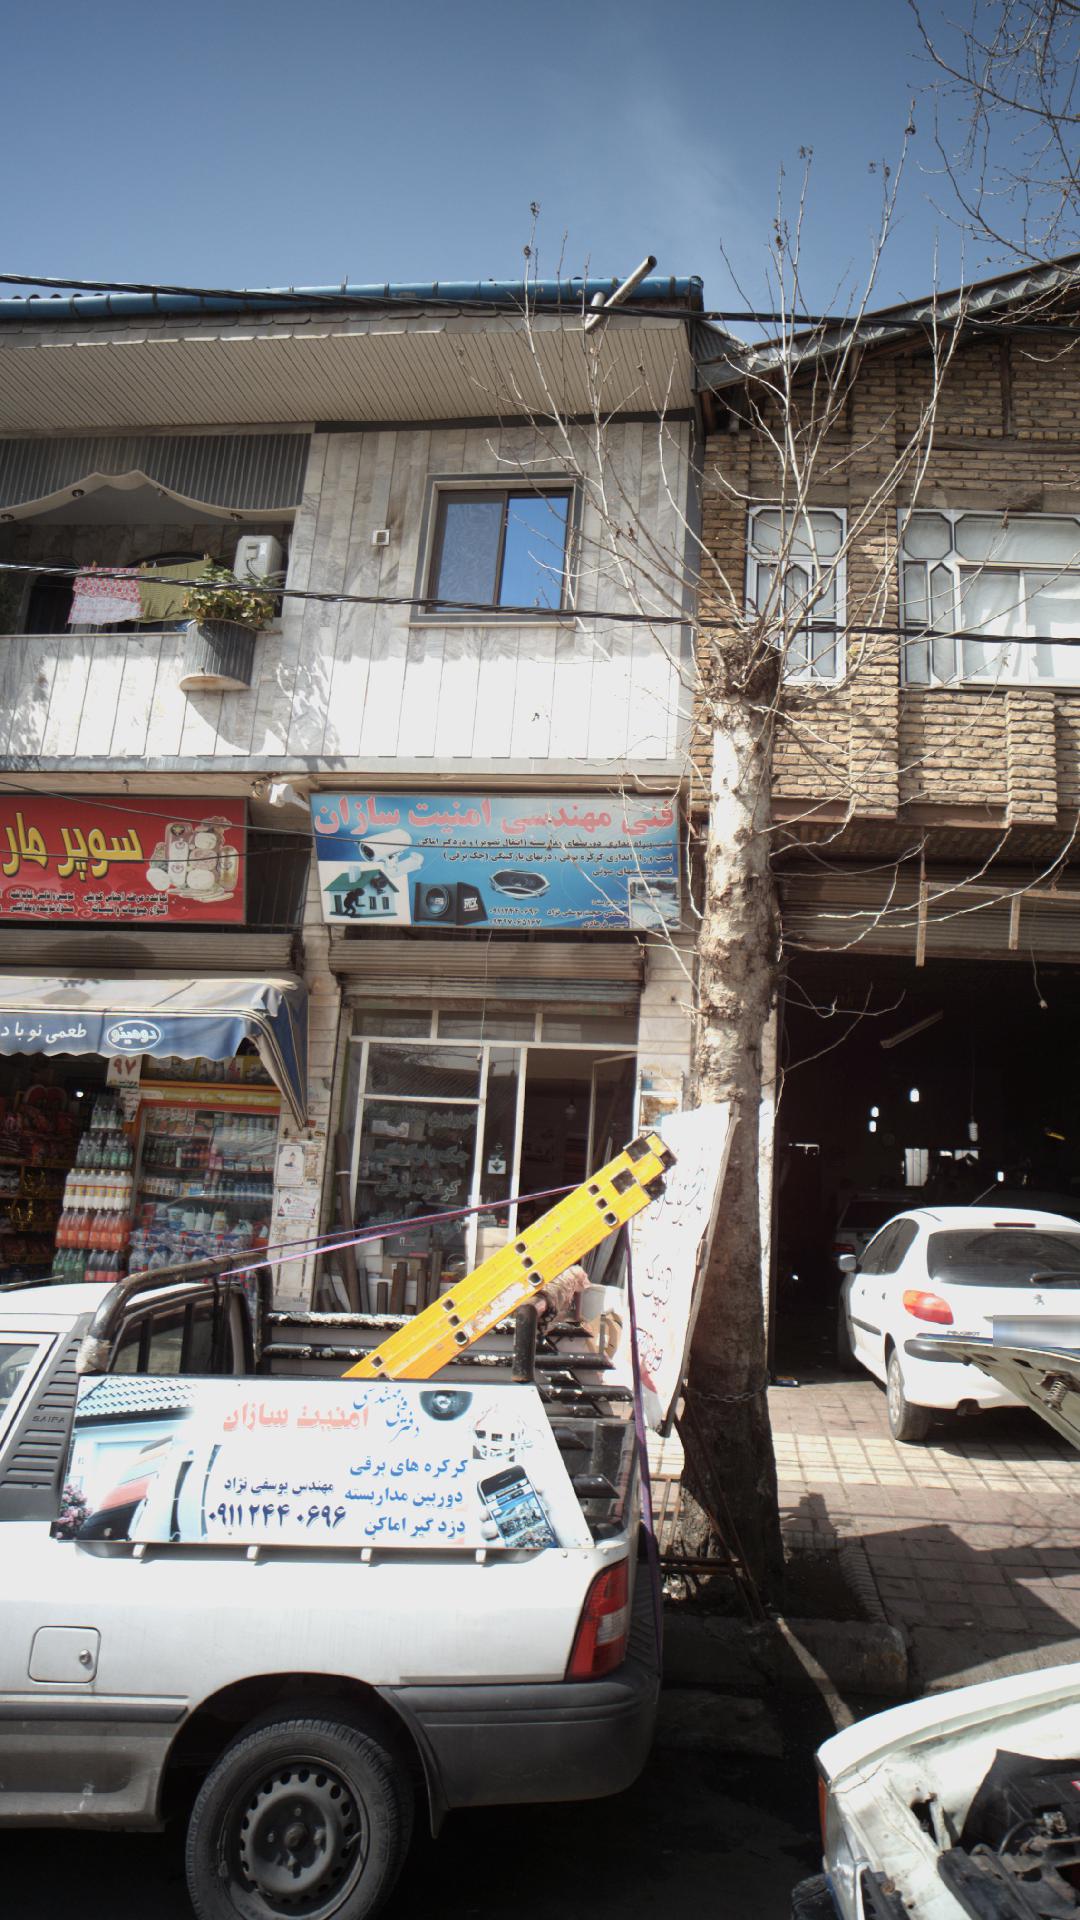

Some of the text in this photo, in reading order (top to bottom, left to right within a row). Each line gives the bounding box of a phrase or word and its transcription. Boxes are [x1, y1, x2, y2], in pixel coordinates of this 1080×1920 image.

[314, 797, 675, 836] فنی مهندسی امنیت سازان
[57, 827, 144, 881] سوپر
[45, 1022, 88, 1045] طعمی
[110, 1025, 158, 1045] دومینو
[31, 1415, 66, 1424] SAIPA
[222, 1402, 369, 1432] امنیت سازان
[349, 1456, 468, 1478] کرکره های برقی
[223, 1477, 335, 1496] مهندس یوسفی نژاد
[412, 1488, 465, 1509] دوربین
[363, 1515, 407, 1541] اماکن
